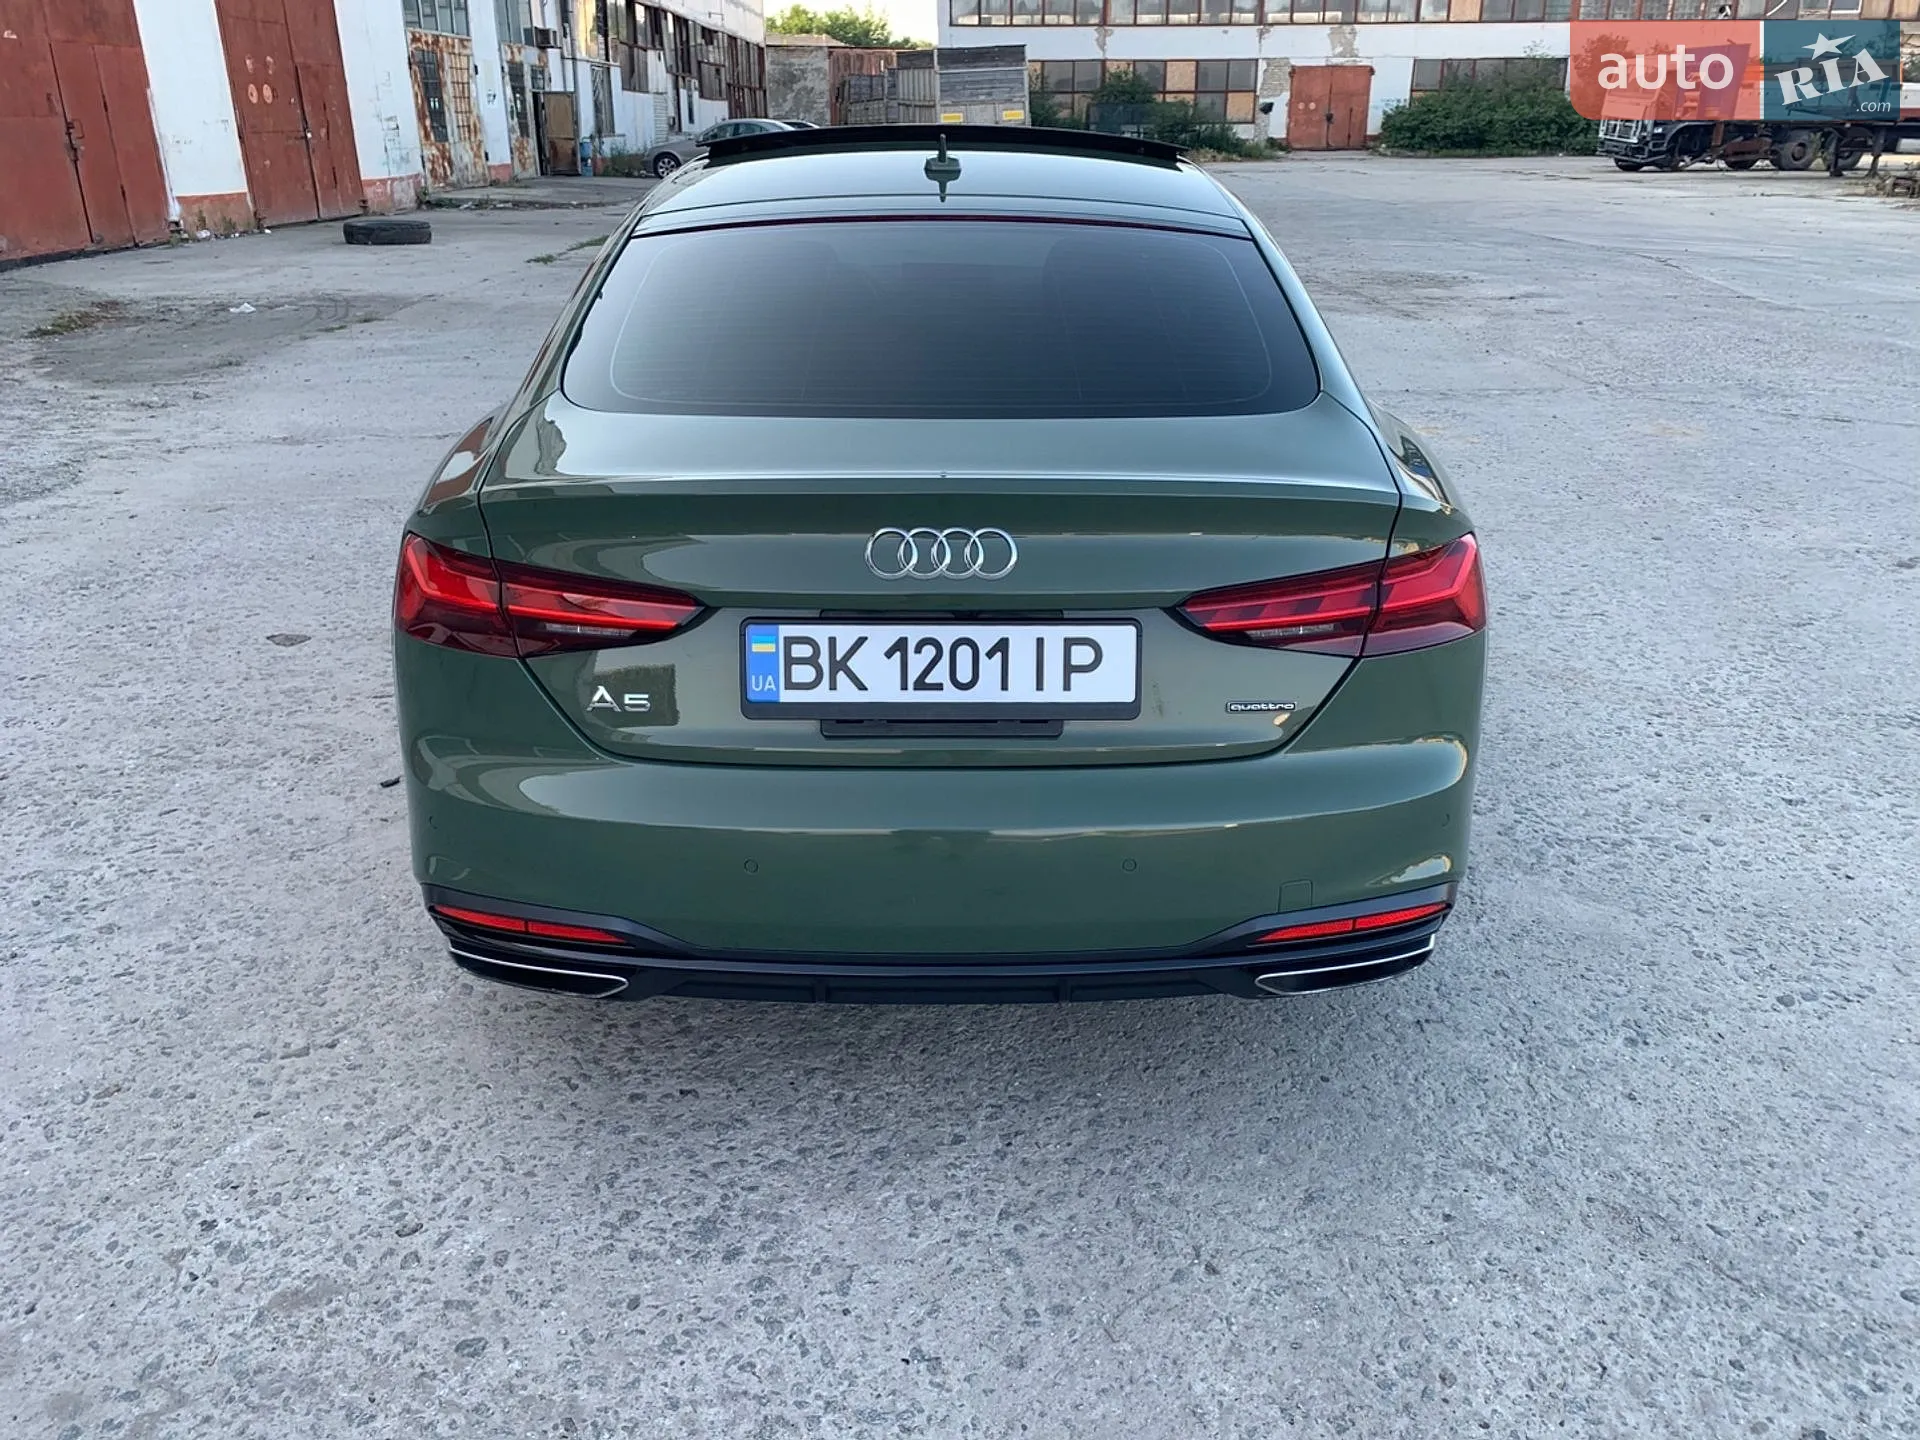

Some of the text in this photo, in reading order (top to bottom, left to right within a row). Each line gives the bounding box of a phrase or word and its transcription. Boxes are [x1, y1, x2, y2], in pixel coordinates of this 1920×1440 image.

[783, 636, 1104, 692] BK 1201 IP
[751, 674, 777, 692] UA
[586, 685, 651, 712] A5
[1229, 702, 1295, 712] quattro
